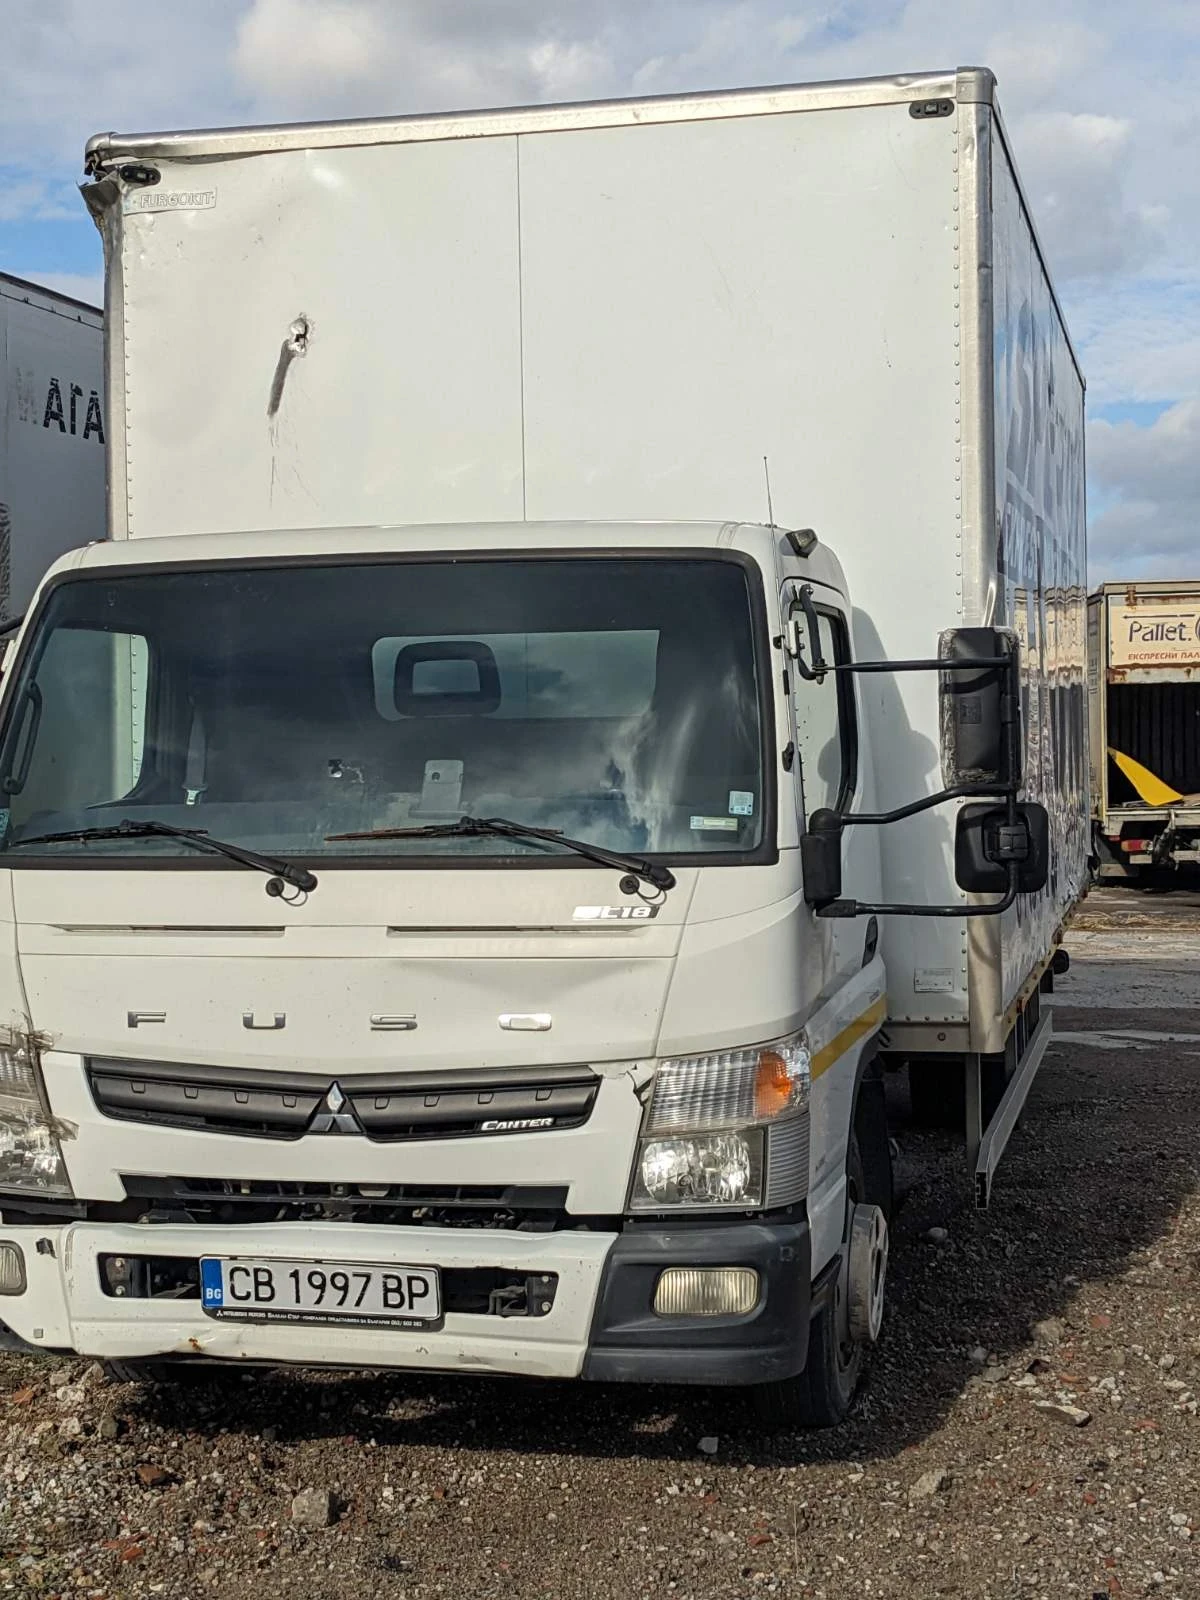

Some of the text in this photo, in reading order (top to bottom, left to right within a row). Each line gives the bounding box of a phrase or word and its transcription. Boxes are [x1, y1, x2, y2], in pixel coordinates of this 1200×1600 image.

[1127, 651, 1178, 661] ЕКСПРЕСНИ
[126, 1010, 553, 1032] FUSO
[481, 1117, 554, 1131] CANTER
[205, 1286, 222, 1300] BG
[288, 1269, 373, 1308] 1997
